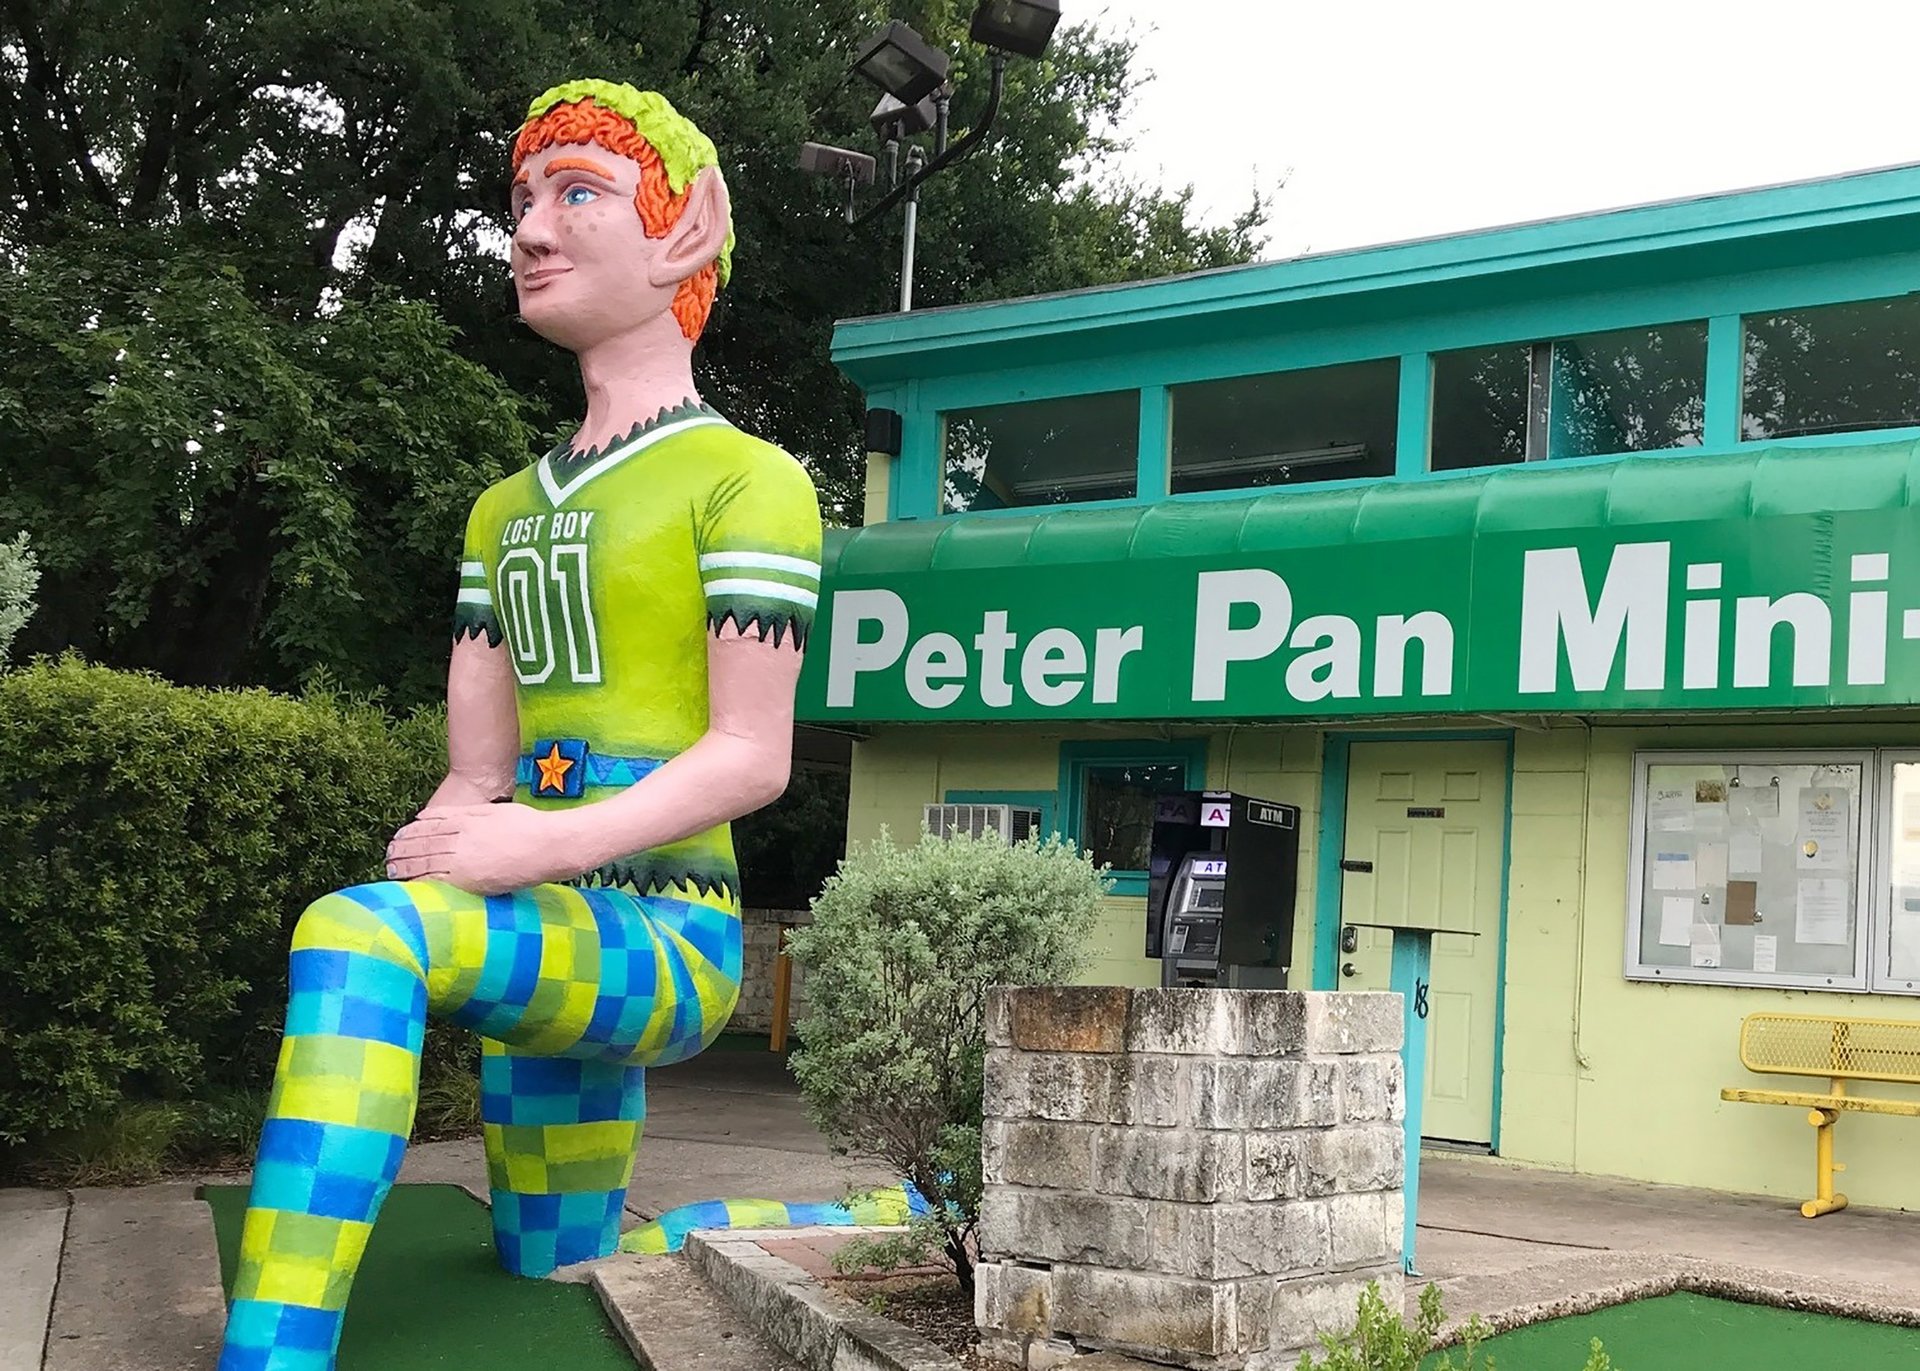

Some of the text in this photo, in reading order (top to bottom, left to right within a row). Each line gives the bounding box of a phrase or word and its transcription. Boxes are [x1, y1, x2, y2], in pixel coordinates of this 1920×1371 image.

[501, 511, 594, 546] LOST BOY
[497, 544, 602, 686] 01
[826, 588, 1144, 709] Peter
[1191, 568, 1455, 702] Pan
[1260, 806, 1283, 824] ATM
[1413, 976, 1429, 1019] 18
